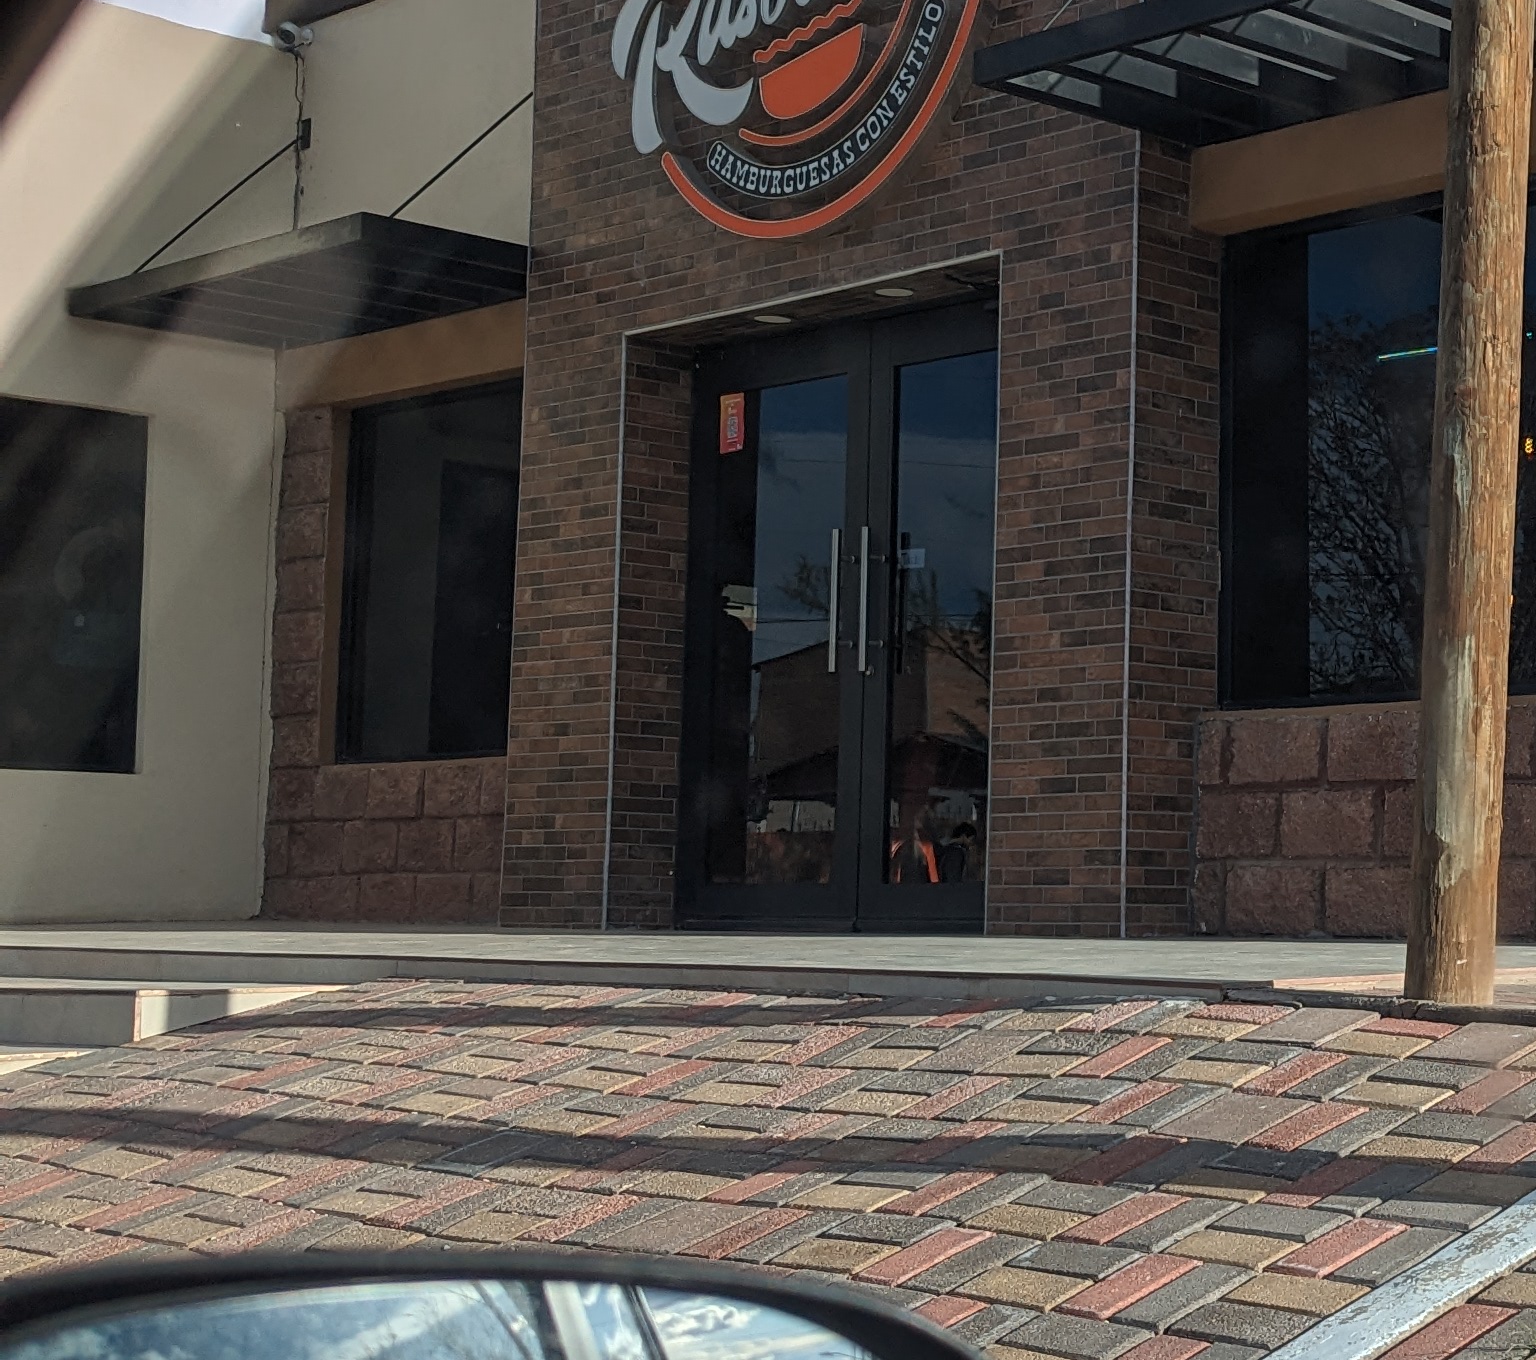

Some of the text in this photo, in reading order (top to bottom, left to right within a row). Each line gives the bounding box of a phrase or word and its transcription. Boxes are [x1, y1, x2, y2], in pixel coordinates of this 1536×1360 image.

[710, 2, 943, 194] HAMBURGUESAS CON ESTILO
